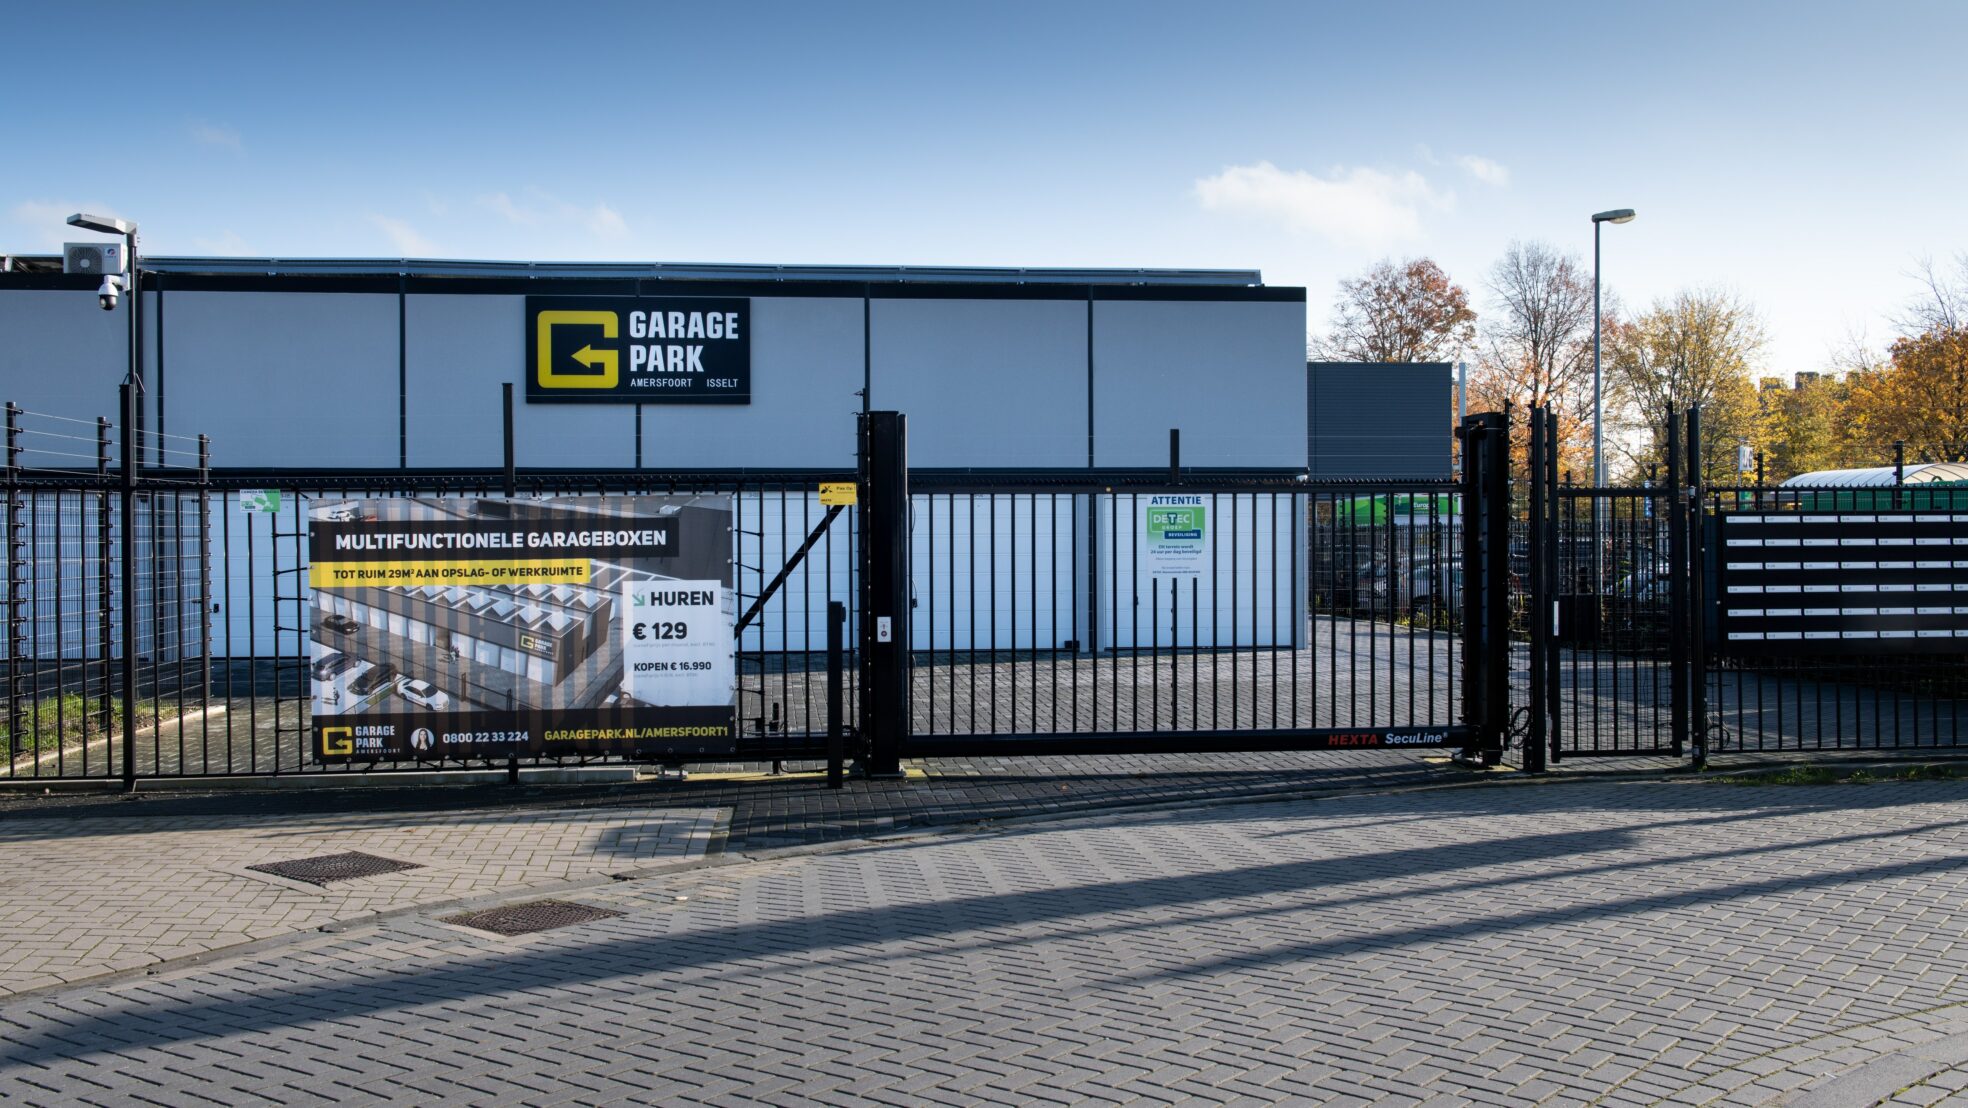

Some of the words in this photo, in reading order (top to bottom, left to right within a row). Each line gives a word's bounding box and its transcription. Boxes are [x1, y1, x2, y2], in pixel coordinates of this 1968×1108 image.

[629, 311, 739, 340] GARAGE
[630, 344, 704, 373] PARK
[630, 378, 692, 388] AMERSFOORT
[706, 378, 739, 388] ISSELT
[1151, 496, 1202, 505] ATTENTIE
[1153, 513, 1190, 524] DETEC
[335, 531, 524, 550] MULTIFUNCTIONELE
[527, 530, 667, 548] GARAGEBOXEN
[333, 570, 357, 579] TOT
[357, 569, 387, 579] RUIM
[388, 568, 415, 578] 29M²
[415, 568, 440, 578] AAN
[441, 567, 490, 578] OPSLAG-
[491, 567, 508, 577] OF
[508, 566, 583, 577] WERKRUIMTE
[650, 590, 714, 606] HUREN
[632, 622, 647, 640] €
[652, 622, 688, 640] 129
[634, 662, 668, 672] KOPEN
[670, 662, 677, 671] €
[679, 661, 712, 670] 16.990
[355, 725, 395, 737] GARAGE
[442, 732, 473, 744] 0800
[475, 732, 489, 743] 22
[491, 731, 505, 742] 33
[507, 731, 529, 742] 224
[544, 726, 729, 741] GARAGEPARK.NL/AMERSFOORT1
[356, 737, 384, 748] PARK
[1328, 734, 1378, 746] HEXTA
